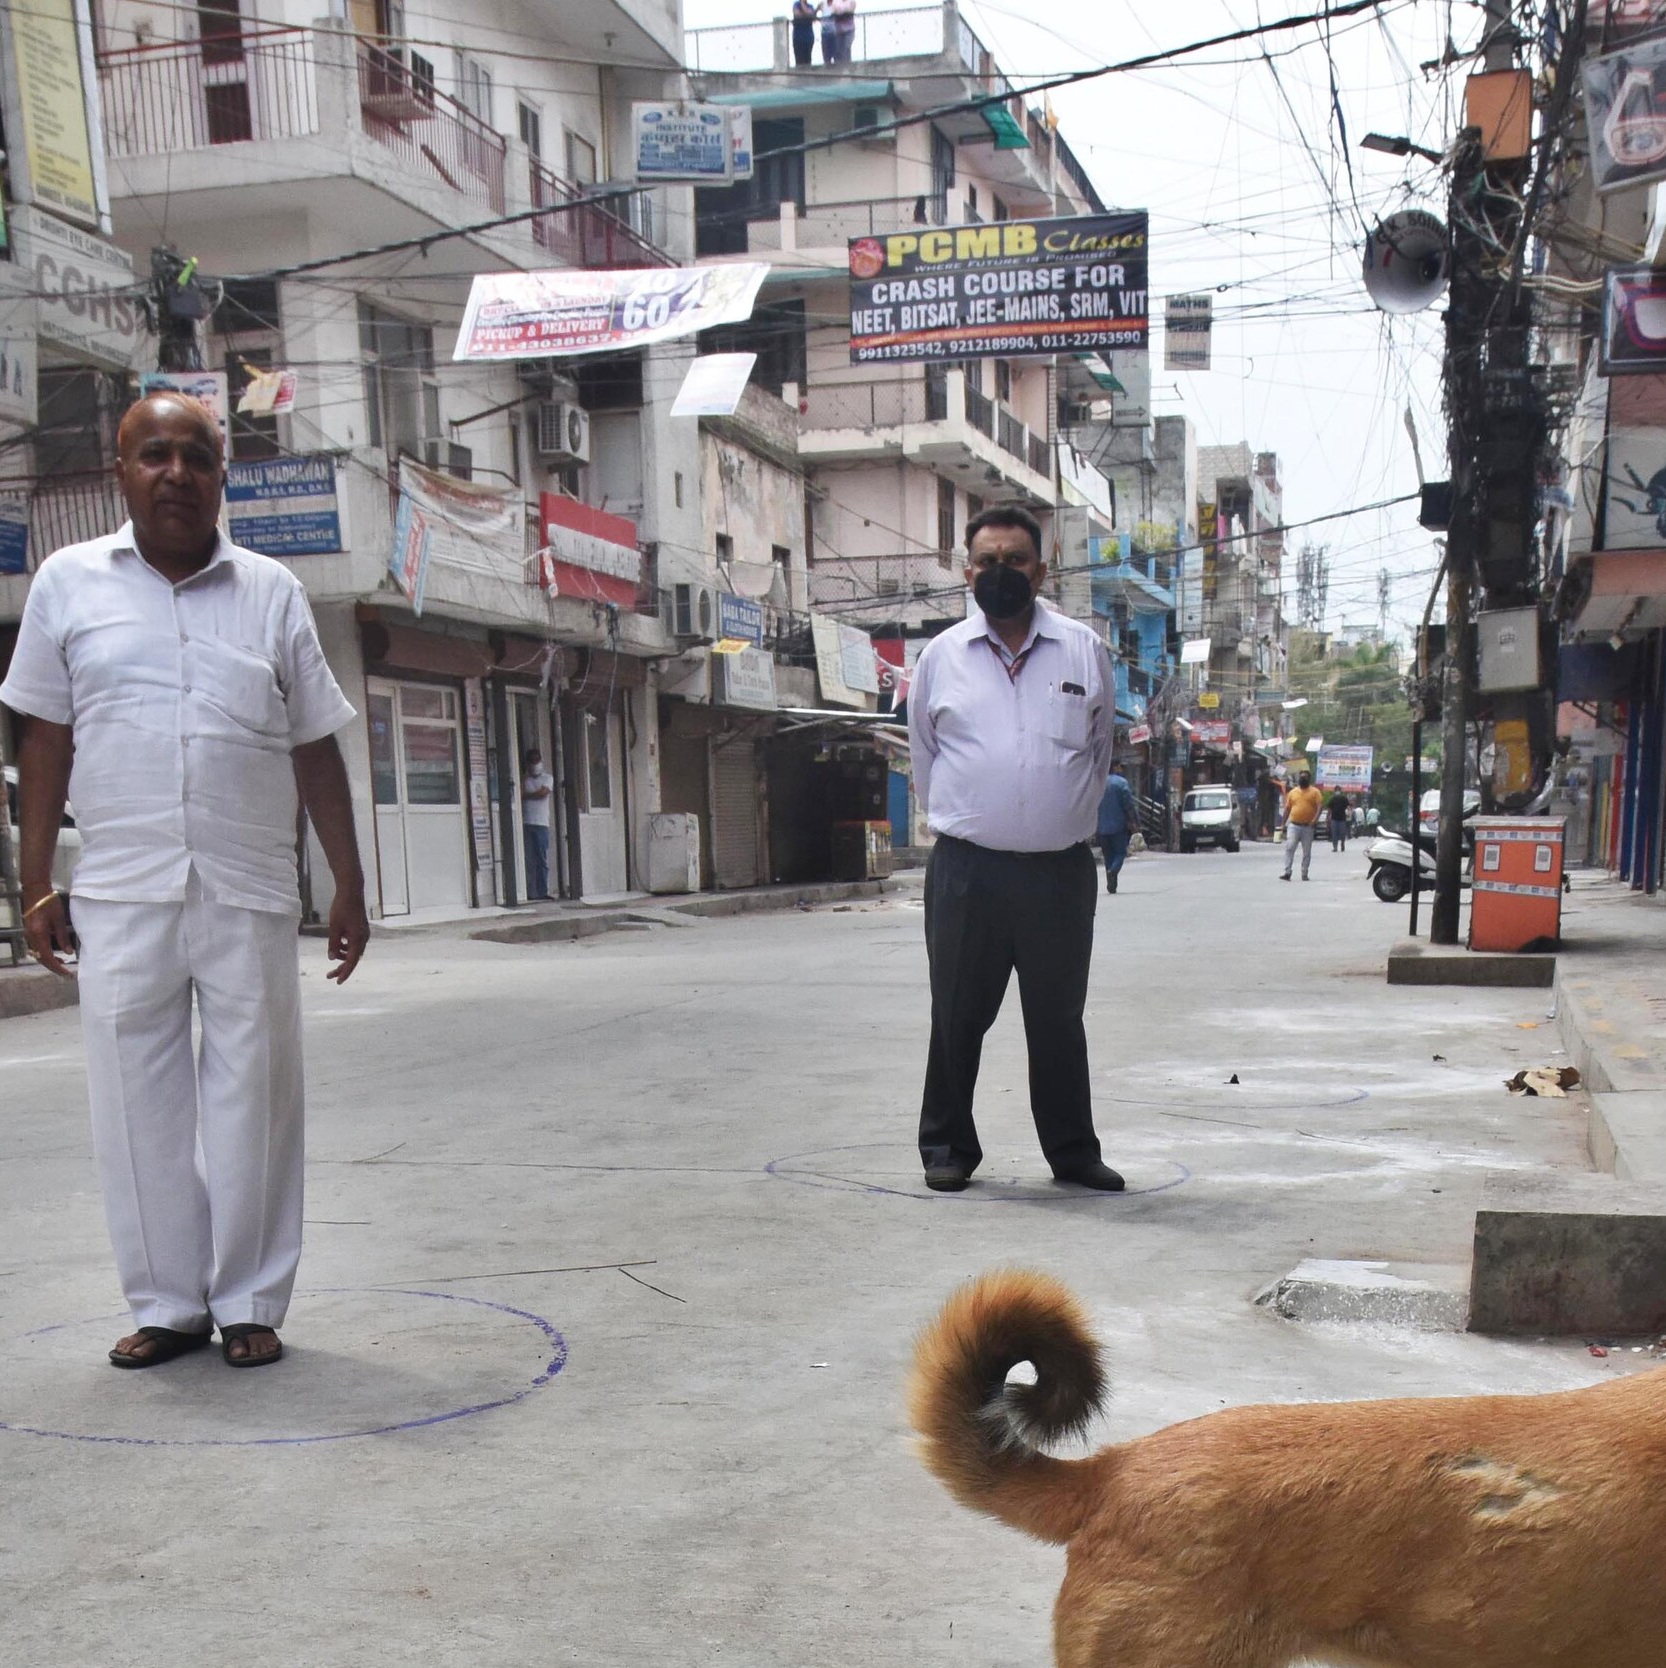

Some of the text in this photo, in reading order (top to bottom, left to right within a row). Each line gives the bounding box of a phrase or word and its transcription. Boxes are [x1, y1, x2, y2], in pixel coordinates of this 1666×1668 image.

[887, 224, 1144, 267] PCMB Classes
[35, 253, 135, 337] CGHS
[871, 264, 1126, 305] CRASH COURSE FOR
[476, 323, 524, 340] PICKUP
[528, 324, 535, 337] &
[541, 318, 605, 335] DELIVERY
[622, 294, 671, 331] 60
[851, 290, 1147, 334] NEET, BITSAT, JEE-MAINS, SRM, VIT
[858, 341, 946, 360] 9911323542,
[949, 337, 1038, 355] 9212189904,
[1041, 330, 1141, 349] 011-22753590
[226, 466, 264, 489] SHALU
